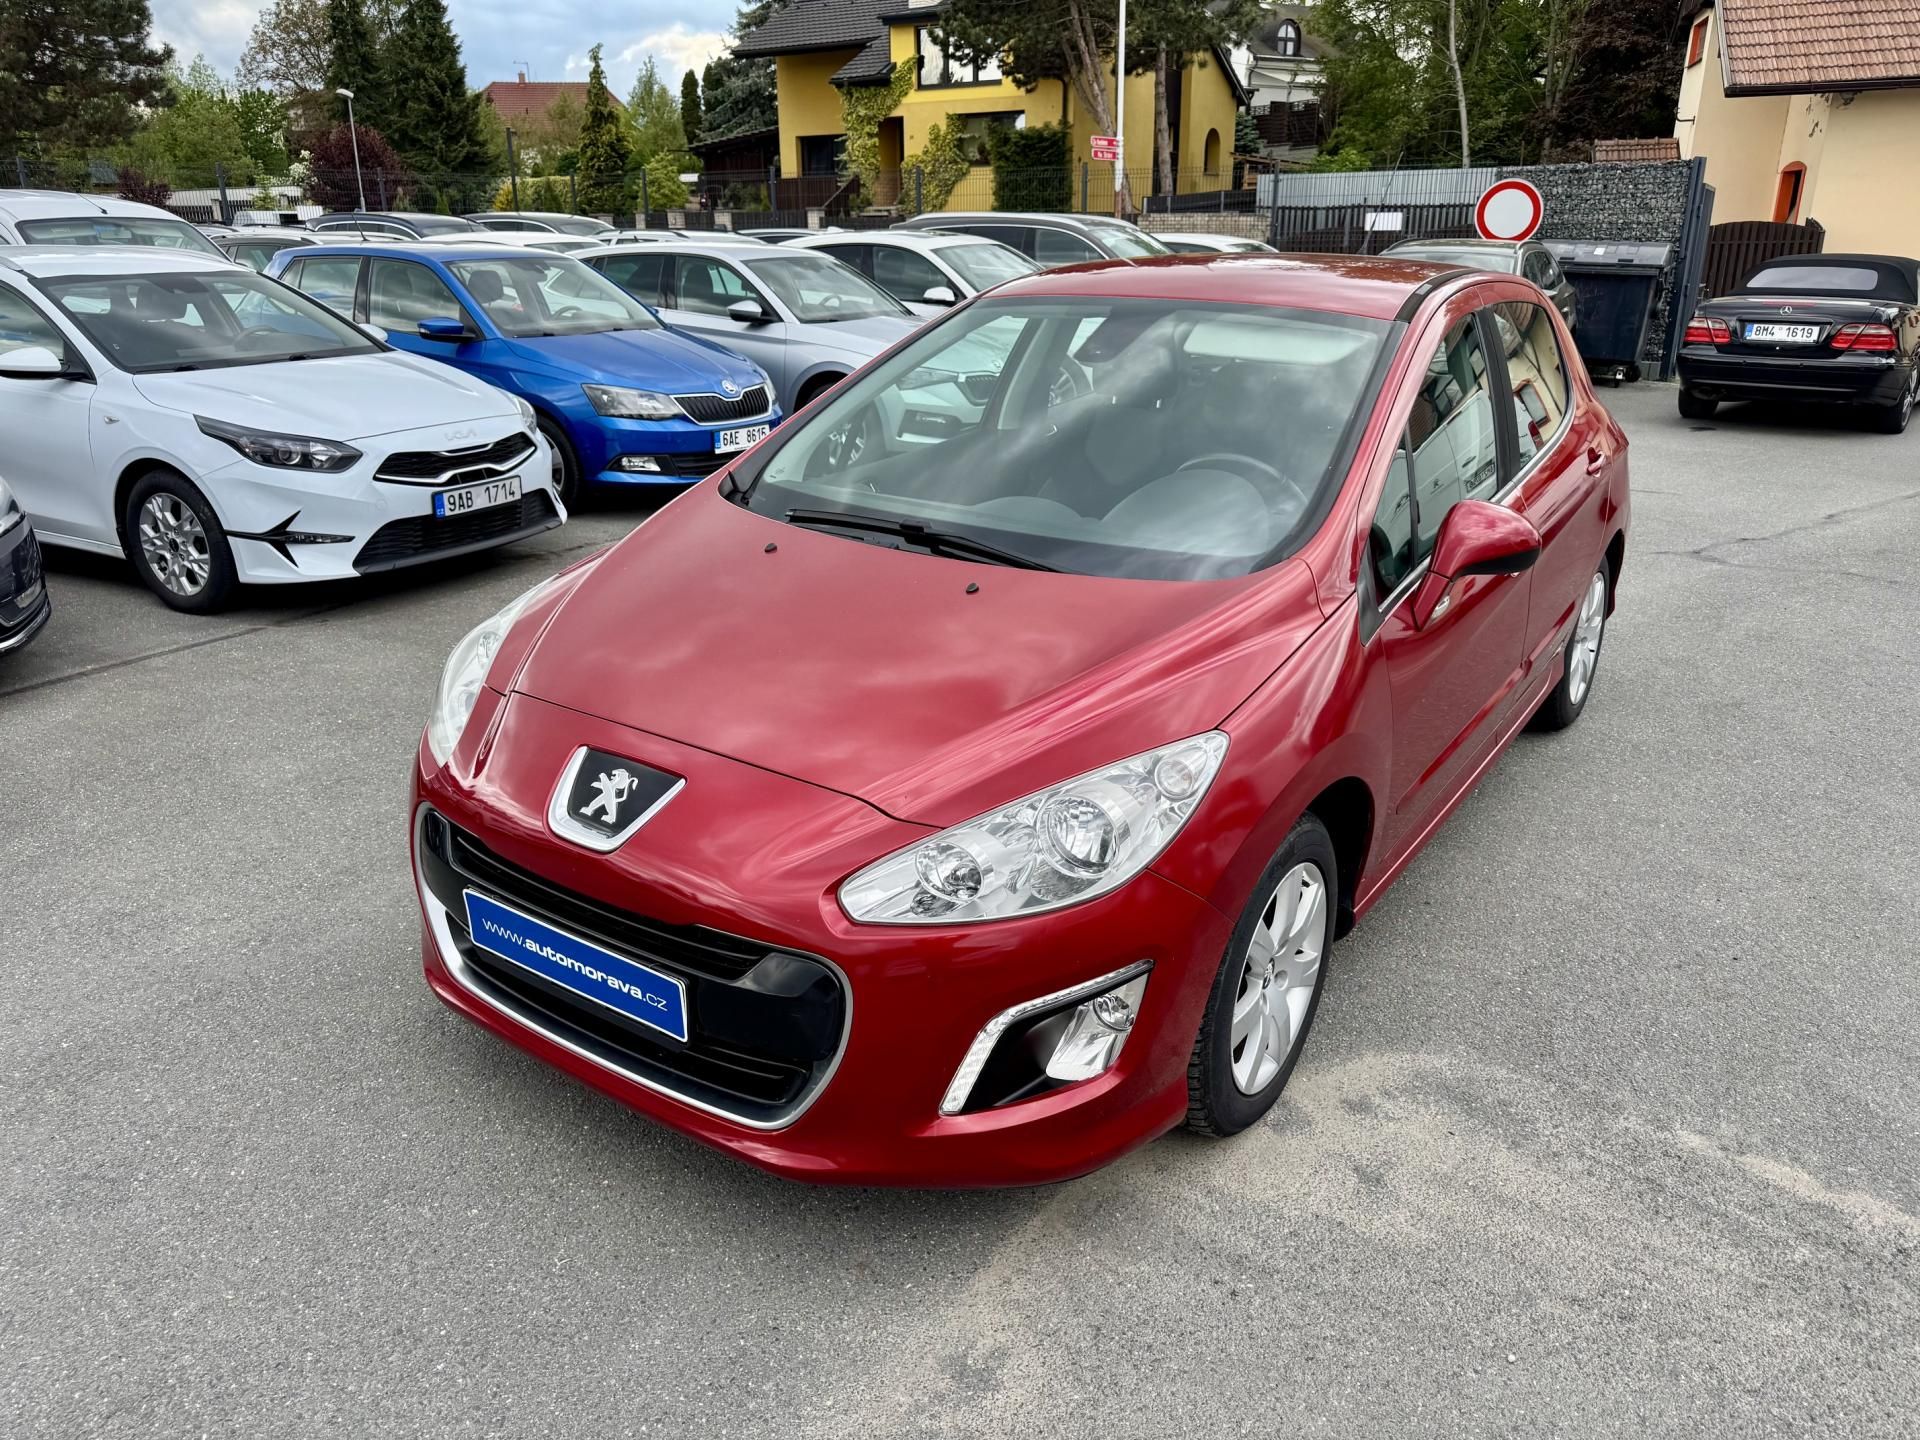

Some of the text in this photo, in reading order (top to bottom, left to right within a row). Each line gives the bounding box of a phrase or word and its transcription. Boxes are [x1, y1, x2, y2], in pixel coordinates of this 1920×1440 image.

[1754, 325, 1775, 337] 8M4
[1785, 326, 1814, 339] 1619
[722, 431, 740, 447] 6AE
[447, 481, 515, 512] 9AB 1714
[482, 918, 668, 1012] www.automorava.cz
